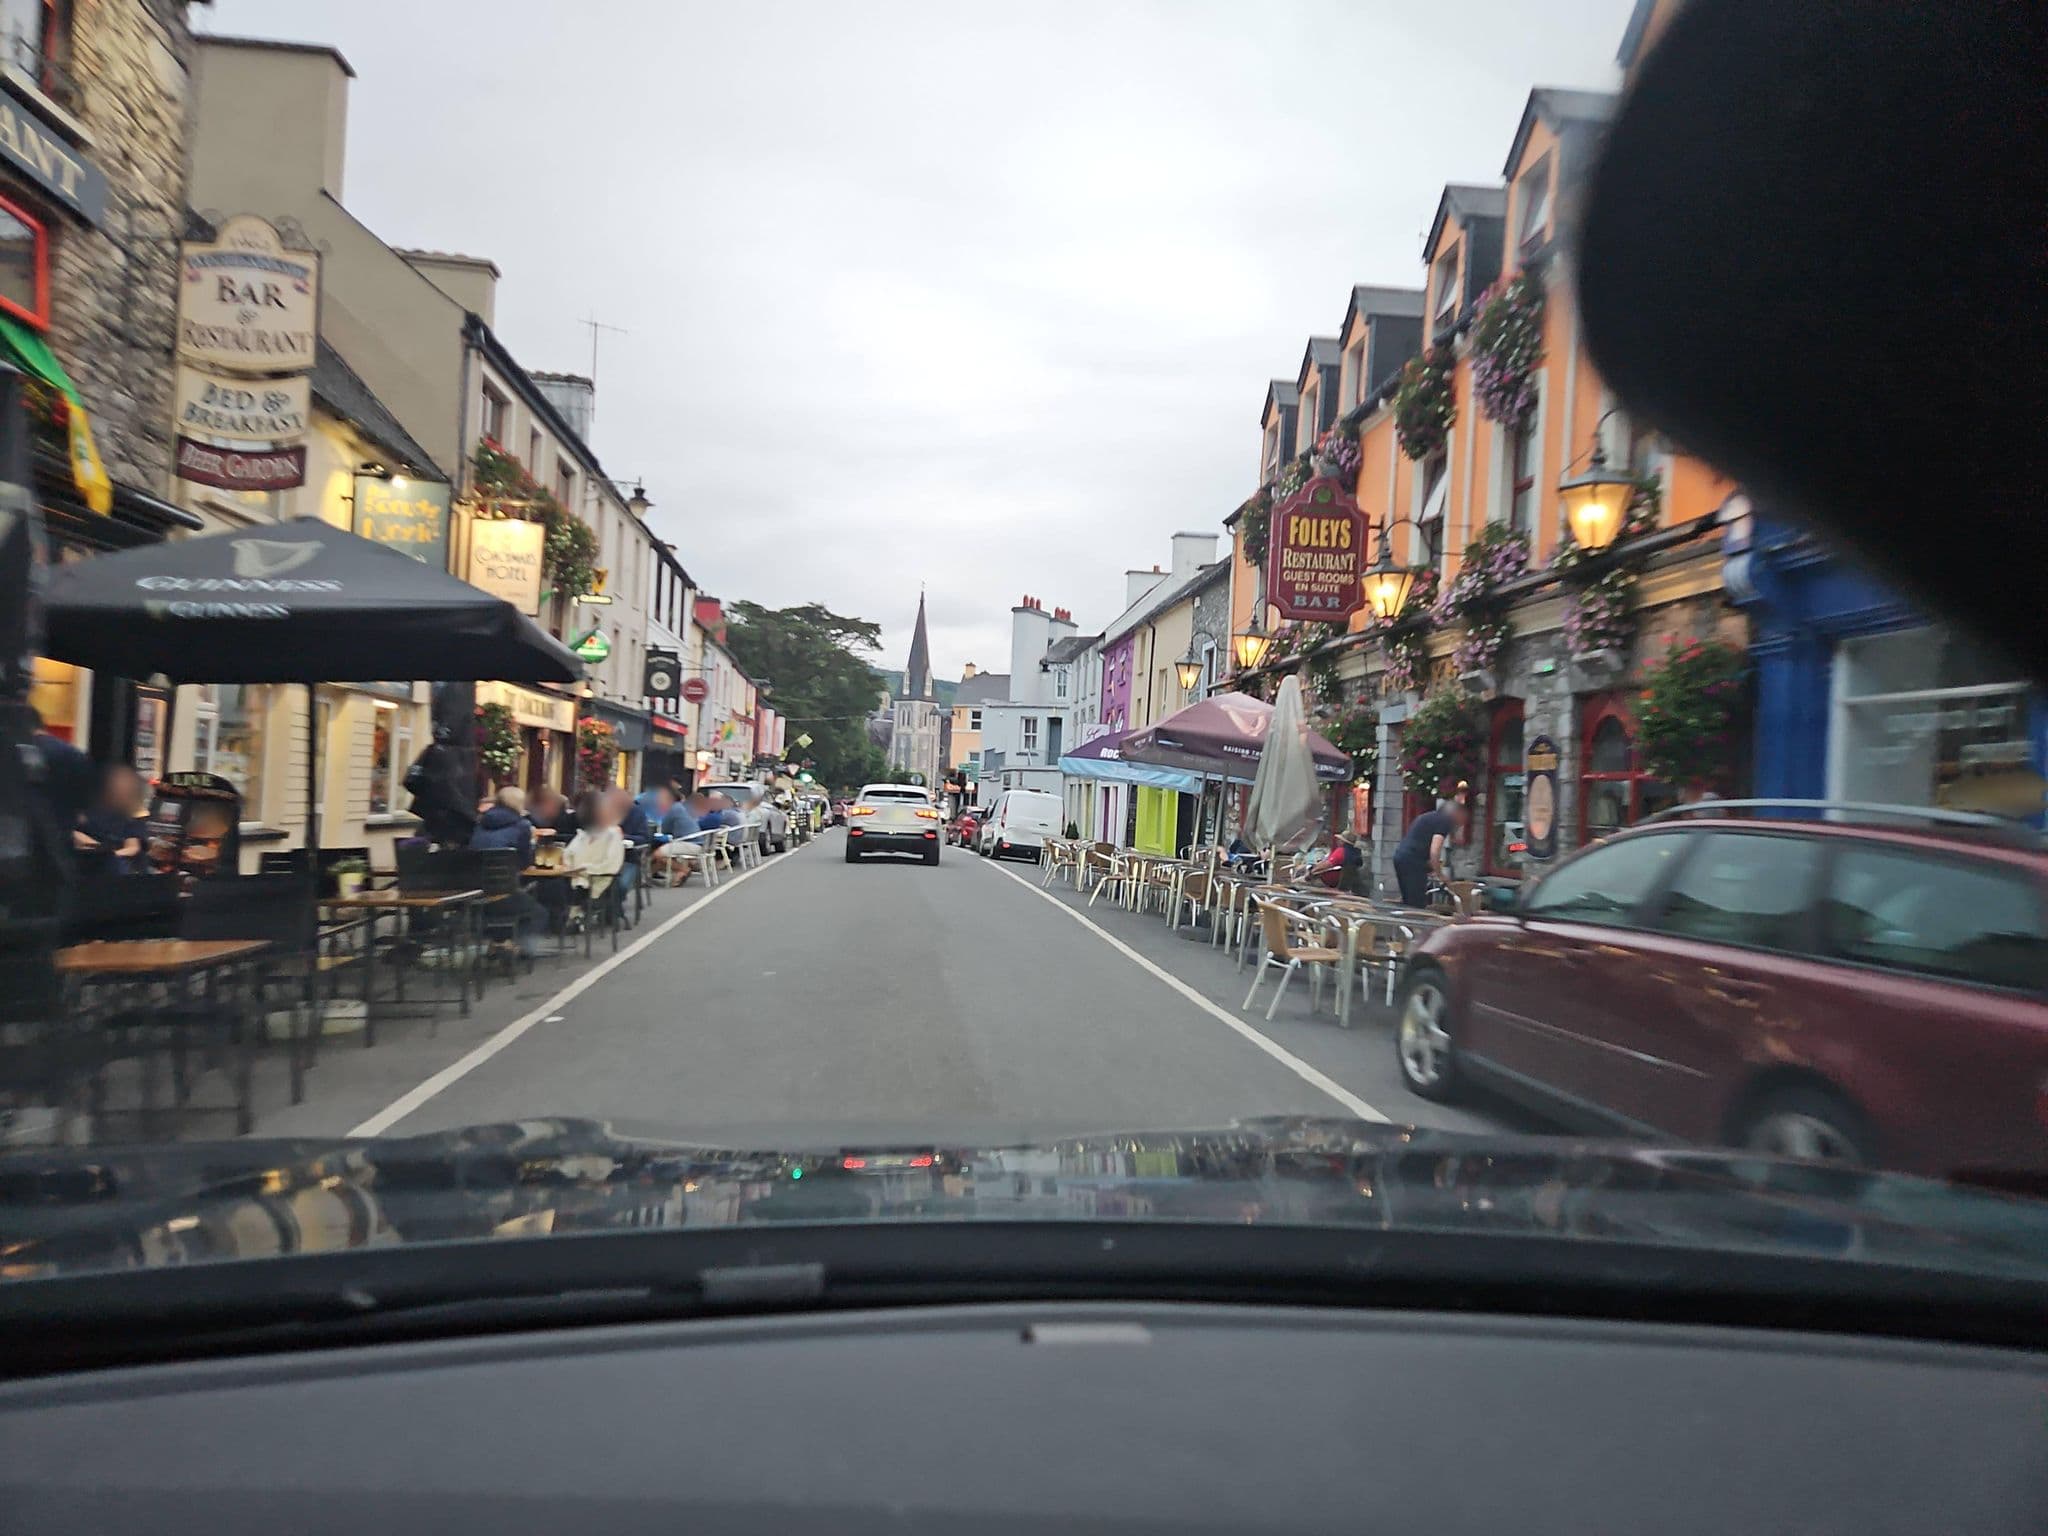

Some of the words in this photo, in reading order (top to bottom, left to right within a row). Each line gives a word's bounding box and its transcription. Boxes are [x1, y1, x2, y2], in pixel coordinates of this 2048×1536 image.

[216, 275, 285, 310] BAR
[202, 381, 254, 411] BED
[263, 390, 290, 414] &
[1289, 515, 1351, 549] FOLEYS
[1282, 547, 1356, 571] RESTAURANT
[1283, 570, 1316, 582] GUEST
[1318, 573, 1354, 585] ROOMS
[1295, 584, 1308, 592] EN
[1311, 584, 1340, 593] SUITE
[1293, 595, 1341, 608] BAR
